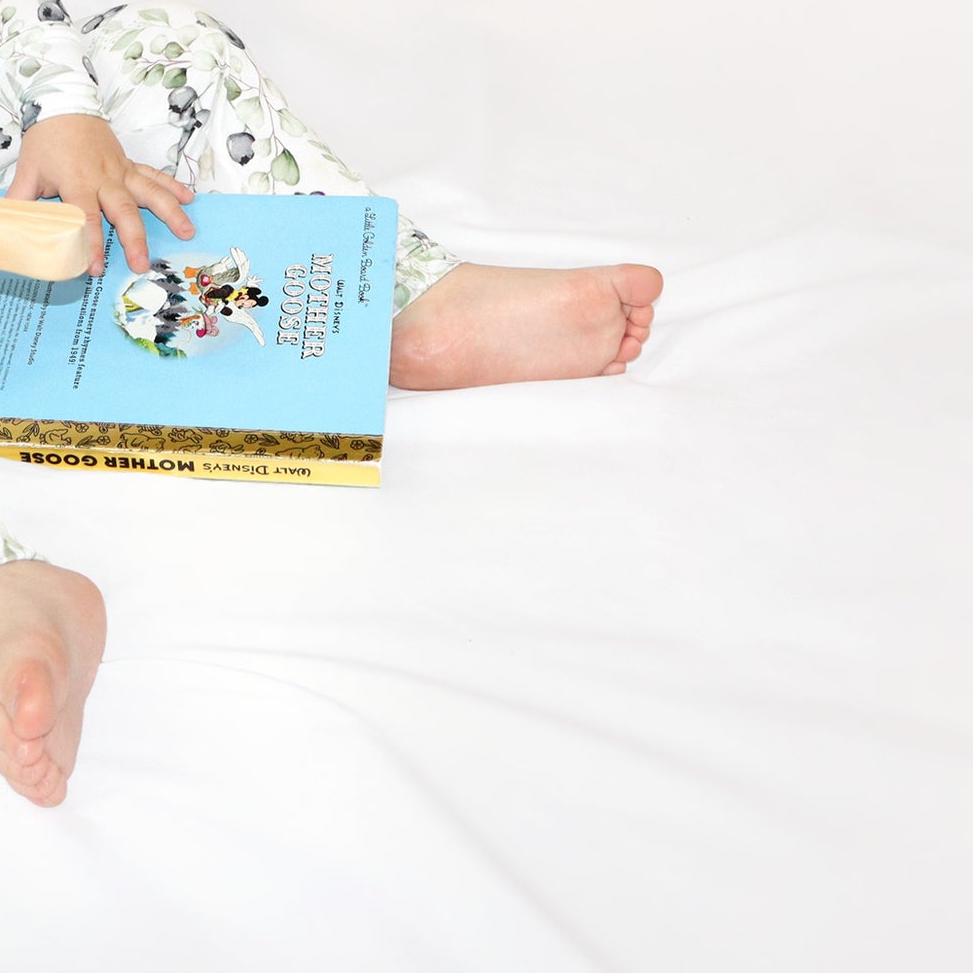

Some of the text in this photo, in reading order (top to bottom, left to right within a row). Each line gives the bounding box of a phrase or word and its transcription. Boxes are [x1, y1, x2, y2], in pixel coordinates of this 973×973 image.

[363, 213, 377, 231] Little
[362, 231, 375, 257] Golden
[359, 258, 373, 283] Board
[77, 285, 92, 328] illustrations
[91, 286, 103, 307] Goose
[277, 263, 307, 345] GOOSE
[300, 253, 334, 359] MOTHER
[84, 308, 97, 335] nursery
[73, 328, 83, 347] from
[79, 335, 91, 363] rhymes
[27, 348, 37, 366] Studio
[68, 347, 79, 365] 1949!
[73, 364, 85, 389] feature
[19, 451, 97, 467] GOOSE
[104, 455, 195, 472] MOTHER
[273, 467, 311, 477] WALT
